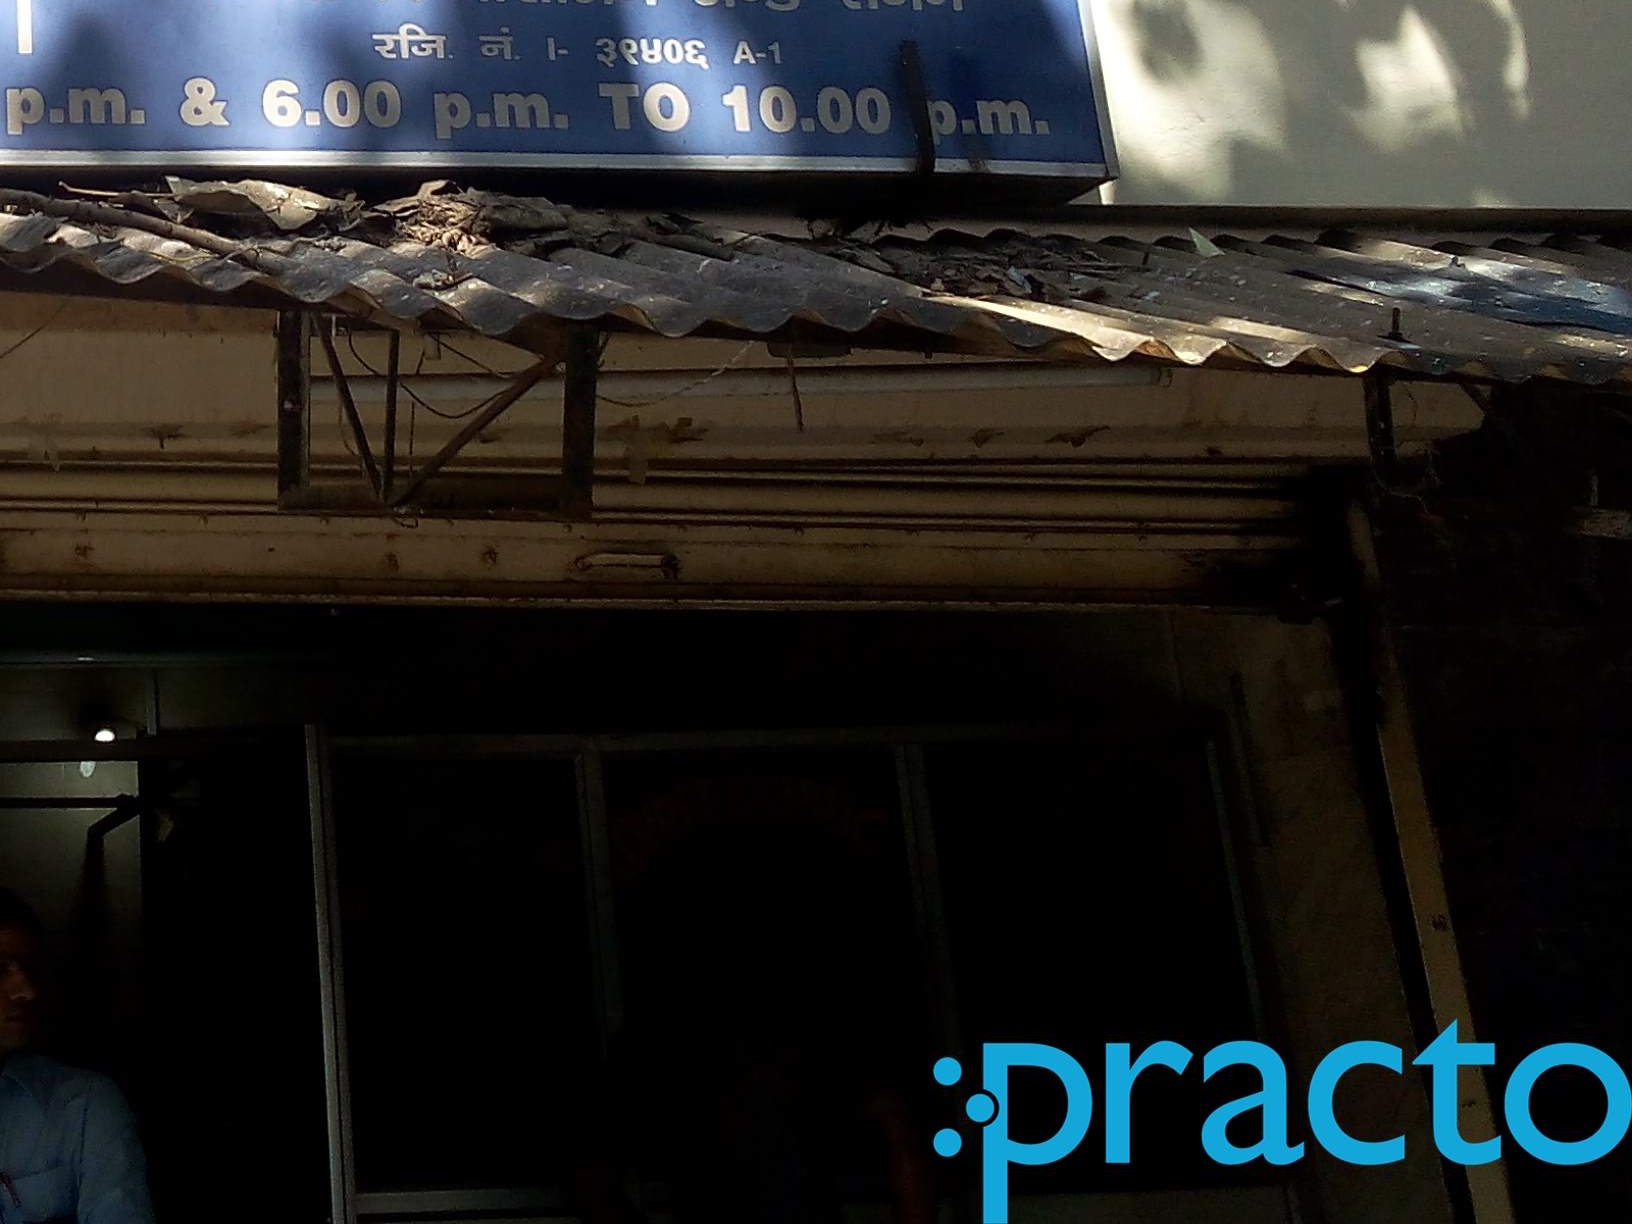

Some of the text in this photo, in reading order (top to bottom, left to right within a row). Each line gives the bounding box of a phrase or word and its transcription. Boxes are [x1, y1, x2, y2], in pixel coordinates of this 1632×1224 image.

[732, 40, 782, 66] A-1
[5, 84, 147, 137] p.m.
[179, 77, 231, 128] &
[261, 78, 403, 129] 6.00
[432, 89, 570, 140] p.m.
[598, 81, 691, 133] TO
[721, 84, 891, 135] 10.00
[926, 98, 1051, 145] p.m.
